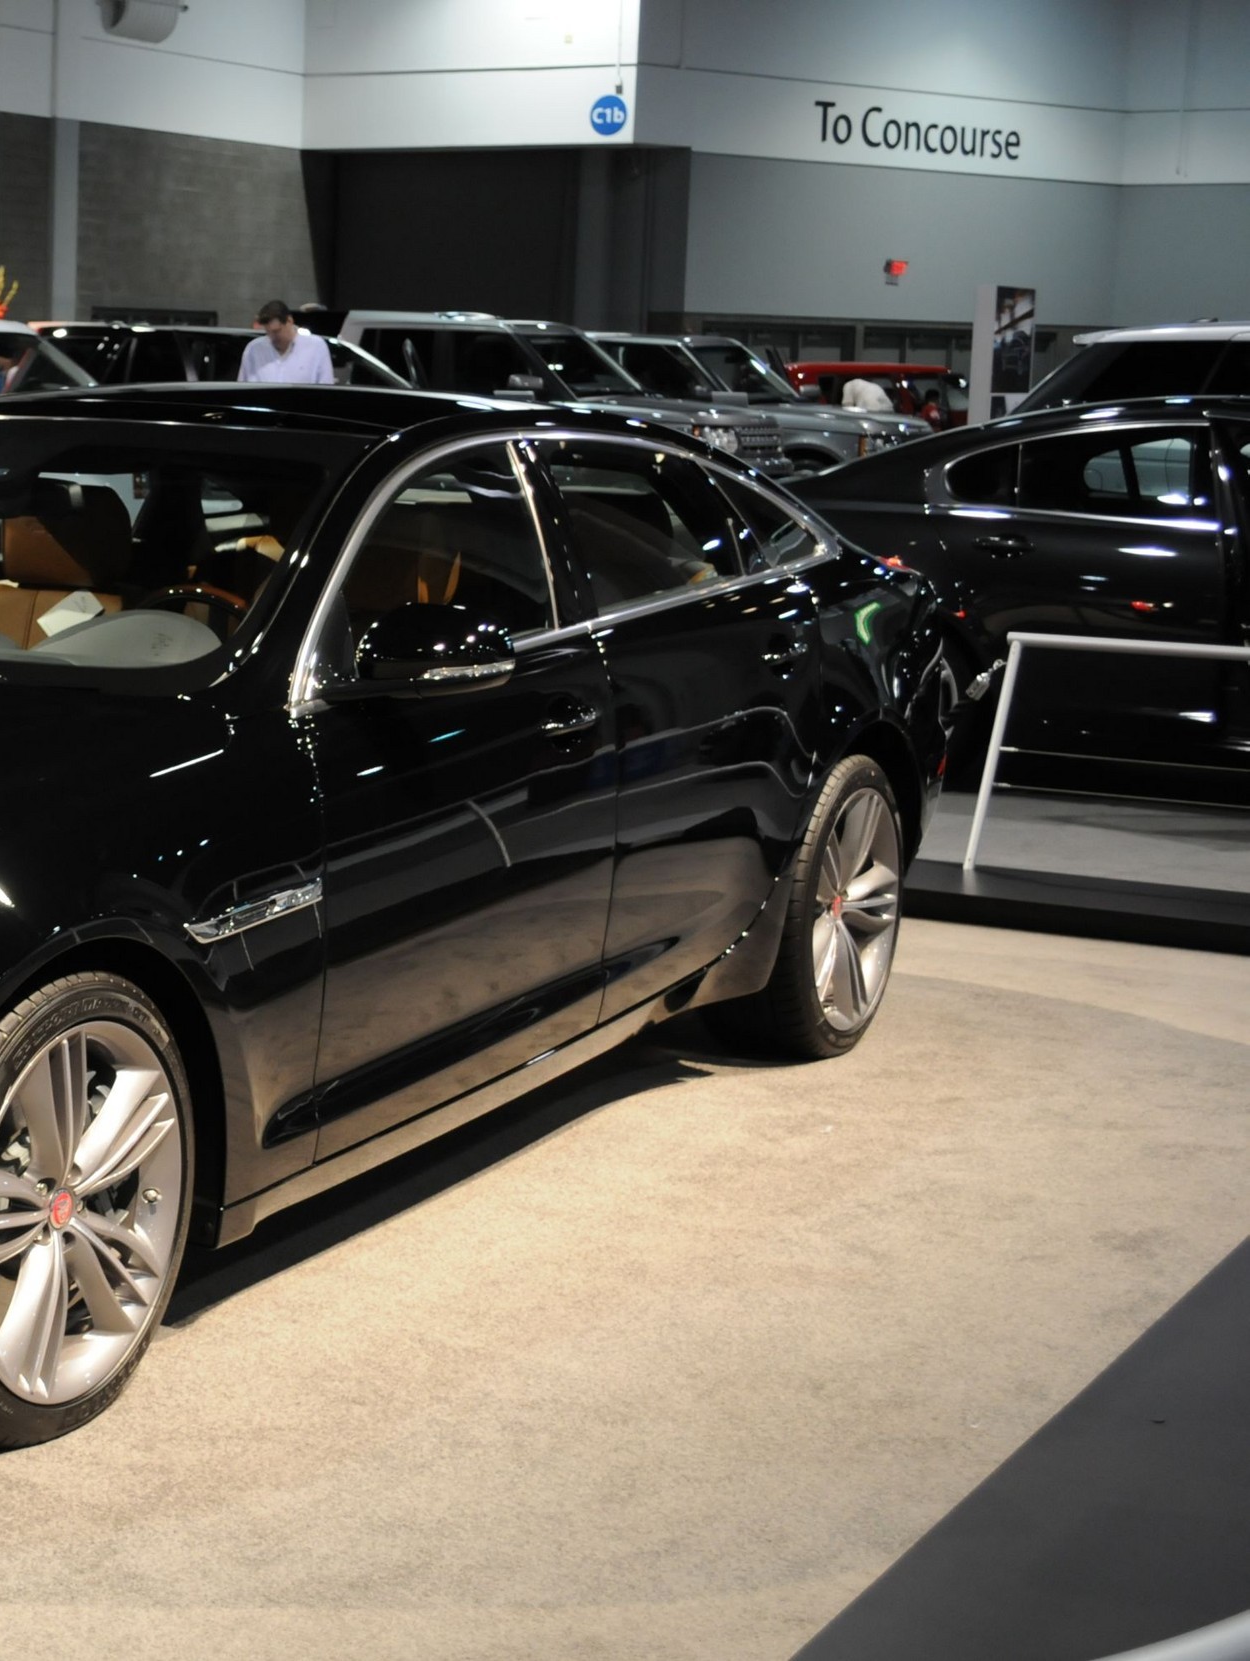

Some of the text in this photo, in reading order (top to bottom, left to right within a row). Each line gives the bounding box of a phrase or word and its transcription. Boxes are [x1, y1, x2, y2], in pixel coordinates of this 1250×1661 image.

[592, 106, 625, 124] C1b
[814, 100, 1021, 160] To Concourse
